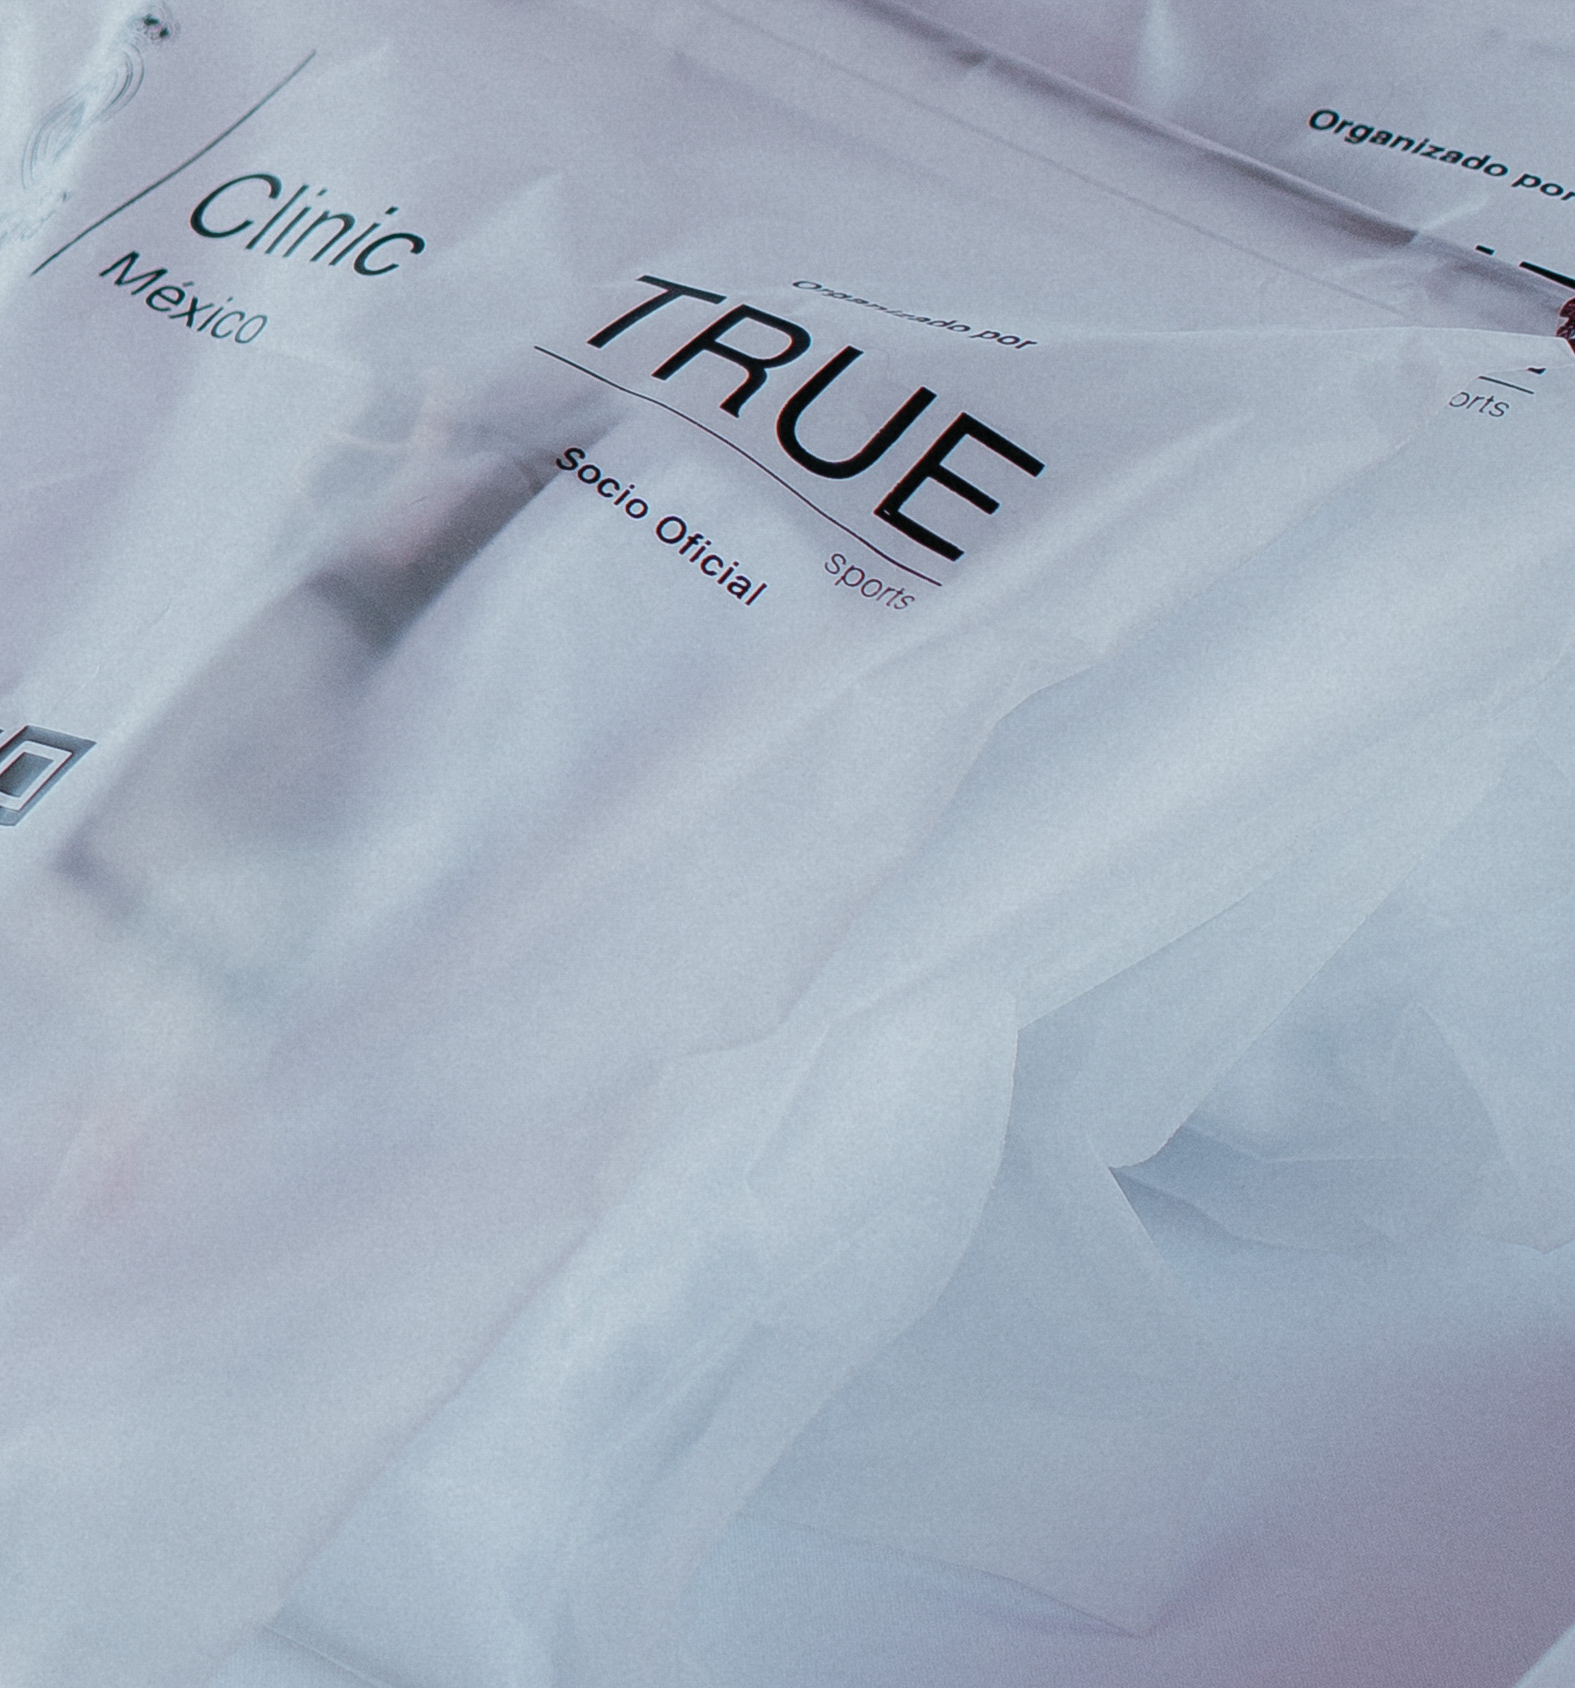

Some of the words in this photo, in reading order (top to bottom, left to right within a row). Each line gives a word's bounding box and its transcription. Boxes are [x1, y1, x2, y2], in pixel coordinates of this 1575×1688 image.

[1308, 109, 1509, 178] Organizado
[189, 173, 426, 277] Clinic
[98, 250, 268, 345] México
[968, 329, 1039, 350] por
[586, 275, 1046, 562] TRUE
[1449, 390, 1511, 419] orts
[554, 447, 650, 520] Socio
[654, 515, 768, 607] Oficial
[824, 552, 917, 611] sports
